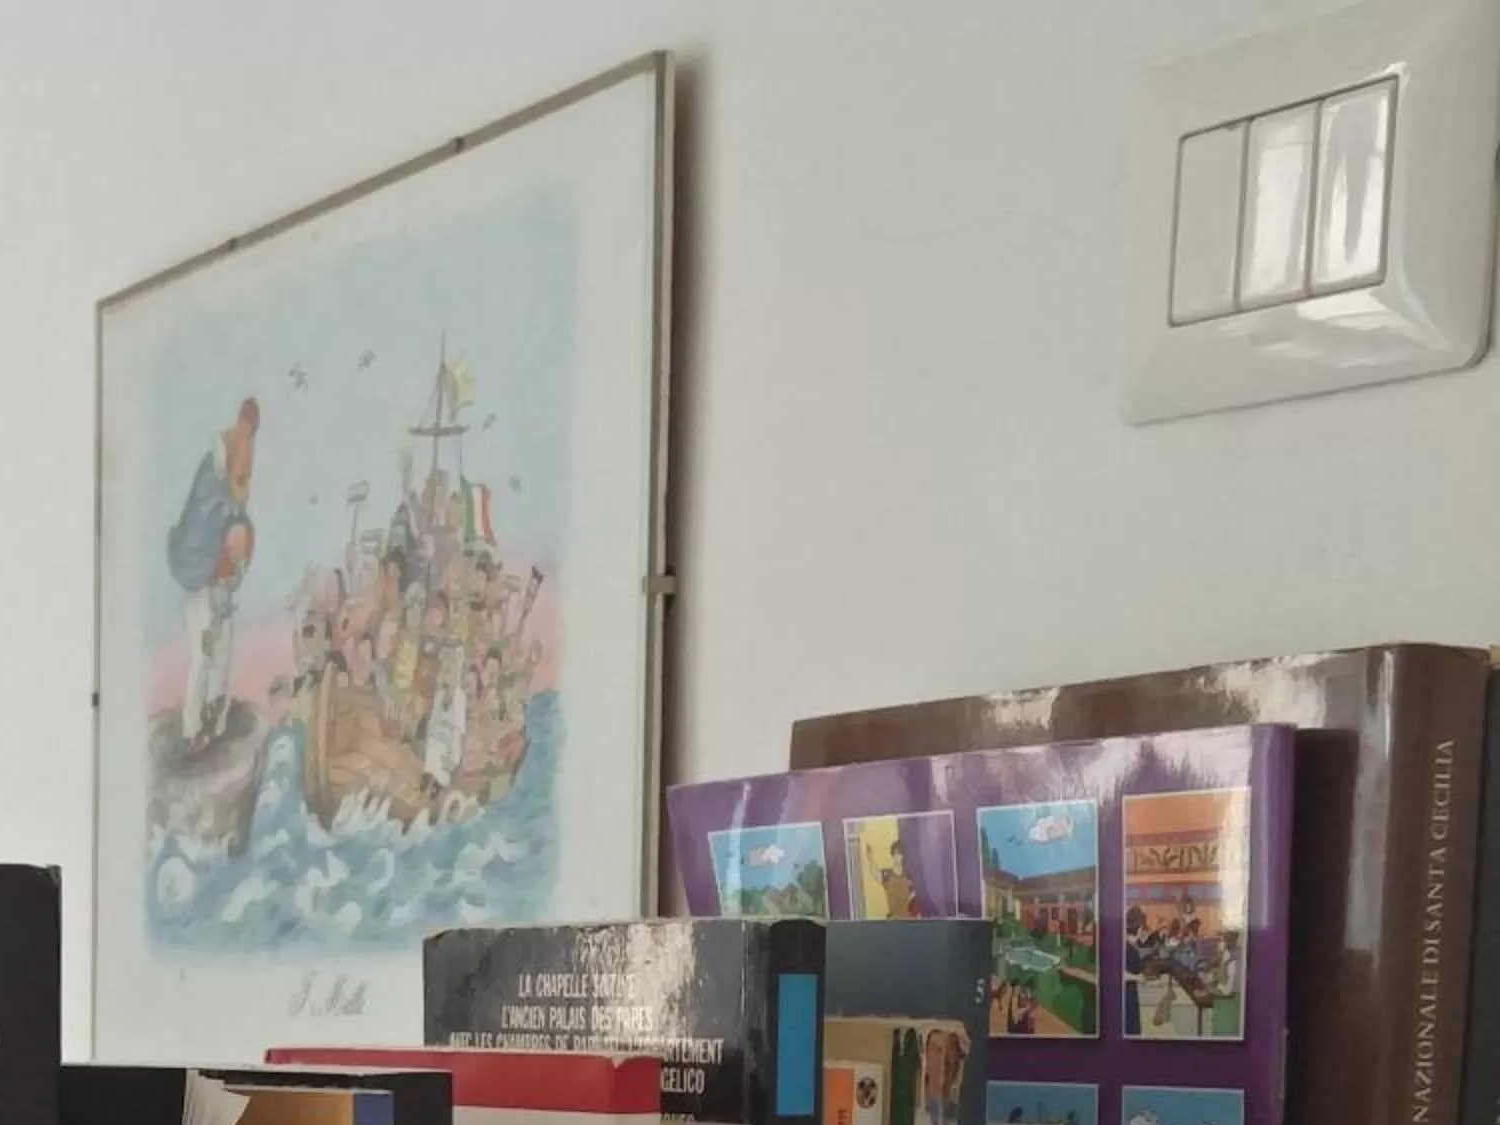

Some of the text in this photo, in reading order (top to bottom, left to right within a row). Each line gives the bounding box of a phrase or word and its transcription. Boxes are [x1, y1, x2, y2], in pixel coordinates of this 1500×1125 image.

[1430, 738, 1456, 841] CECILIA
[1424, 846, 1448, 932] SANTA
[1422, 938, 1443, 965] DI
[518, 973, 533, 998] LA
[535, 973, 588, 998] CHAPELLE
[501, 1005, 545, 1030] L'ANCIEN
[549, 1005, 586, 1031] PALAIS
[1411, 971, 1440, 1124] NAZIONALE
